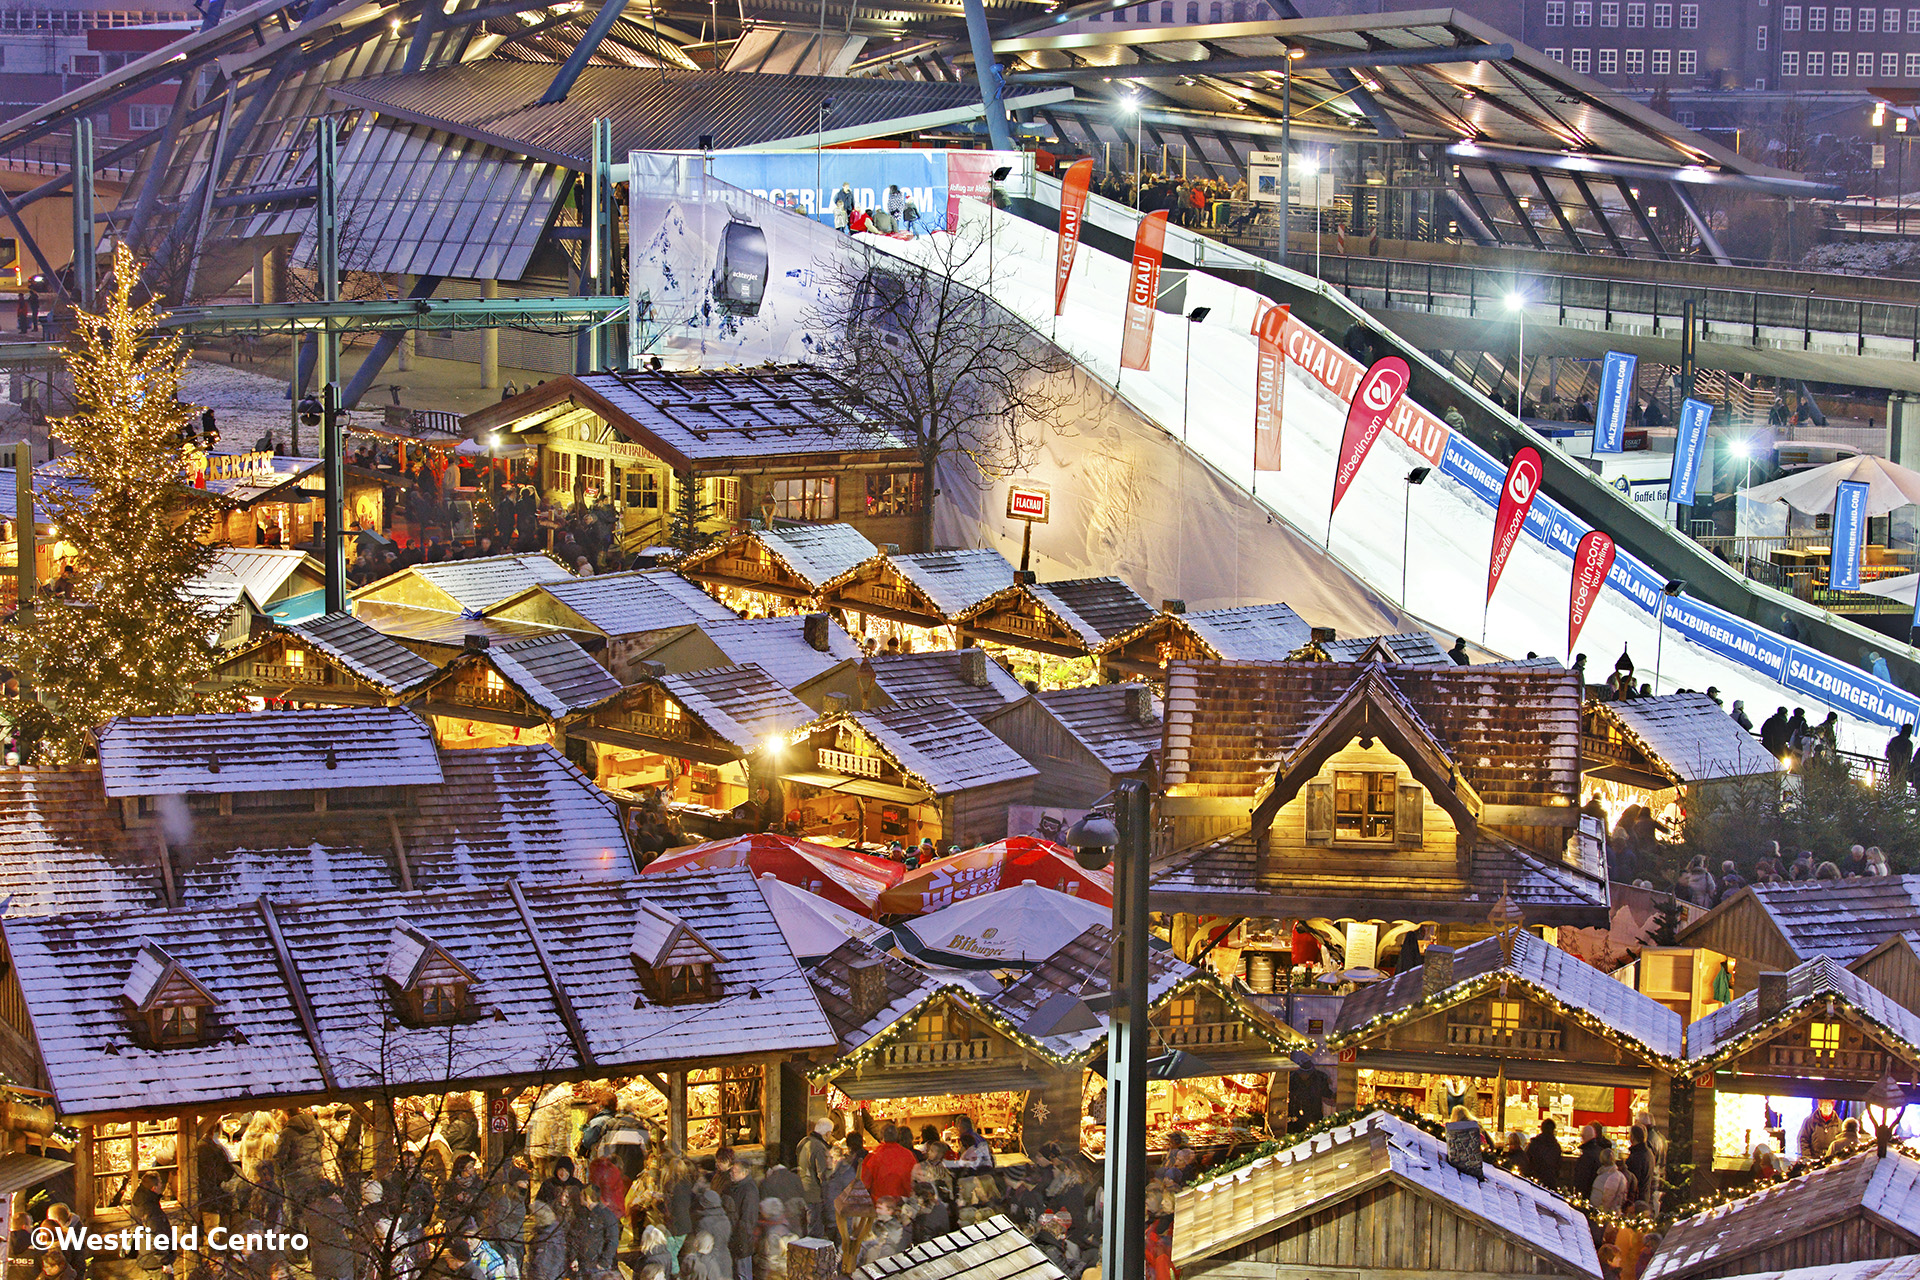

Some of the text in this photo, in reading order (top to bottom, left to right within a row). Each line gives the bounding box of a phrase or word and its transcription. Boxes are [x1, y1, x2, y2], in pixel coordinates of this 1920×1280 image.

[1060, 210, 1077, 279] FLACHAU
[1131, 260, 1151, 331] FLACHAU
[1257, 357, 1274, 430] FLACHAU
[1608, 360, 1628, 446] SALZBURGERLAND.COM
[209, 450, 275, 481] KERZEN
[1339, 415, 1382, 485] airberlin.com
[1680, 409, 1704, 496] SALZBURGERLAND.COM
[1016, 497, 1042, 511] FLACHAU
[1634, 490, 1655, 502] Gaffel
[1491, 508, 1524, 577] airberlin.com
[1573, 535, 1602, 625] airberlin.com
[1591, 567, 1604, 588] Your
[1665, 605, 1782, 670] SALZBURGERLAND.COM
[1790, 659, 1916, 726] SALZBURGERLAND
[946, 934, 1006, 957] Bitburger
